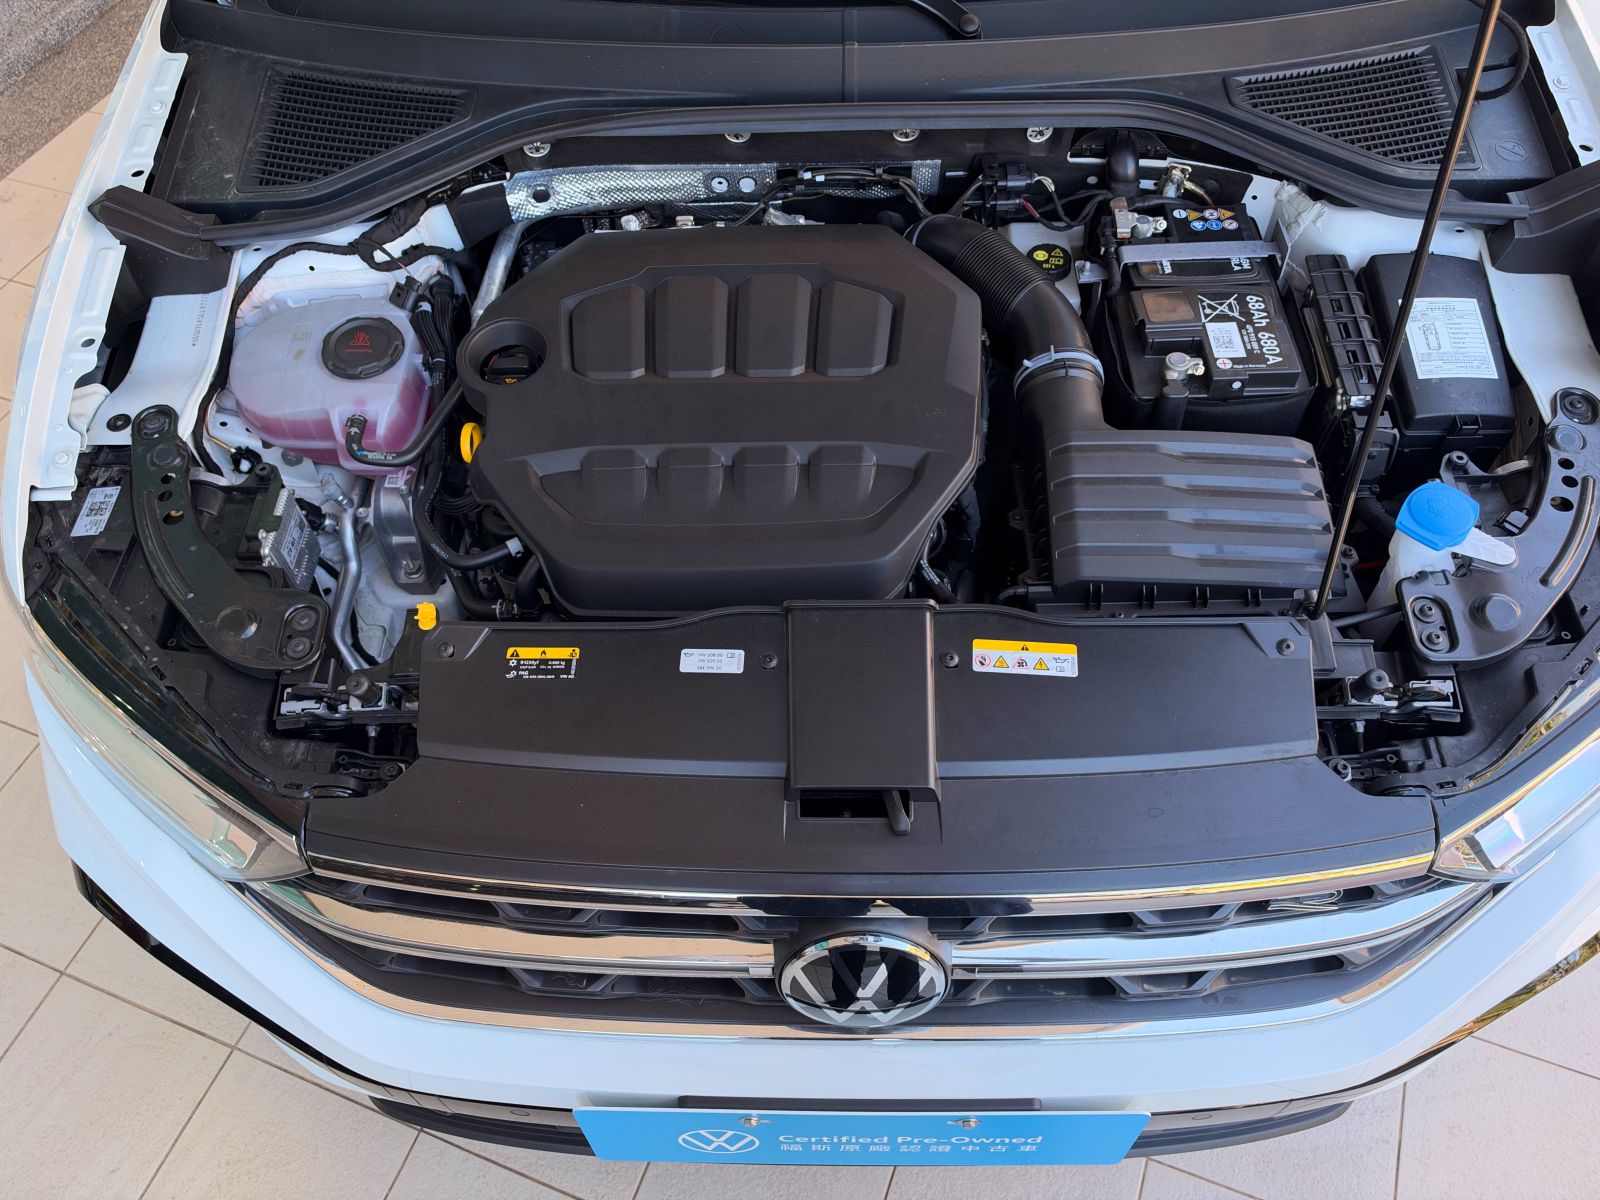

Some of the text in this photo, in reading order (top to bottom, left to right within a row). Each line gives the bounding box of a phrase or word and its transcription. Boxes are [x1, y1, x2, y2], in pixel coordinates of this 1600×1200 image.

[1246, 295, 1270, 327] 68Ah
[1258, 332, 1283, 365] 680A
[678, 1129, 760, 1154] VW
[779, 1135, 1043, 1144] Certified Pre-Owned
[780, 1144, 1038, 1153] 福斯原廠認證中古車
